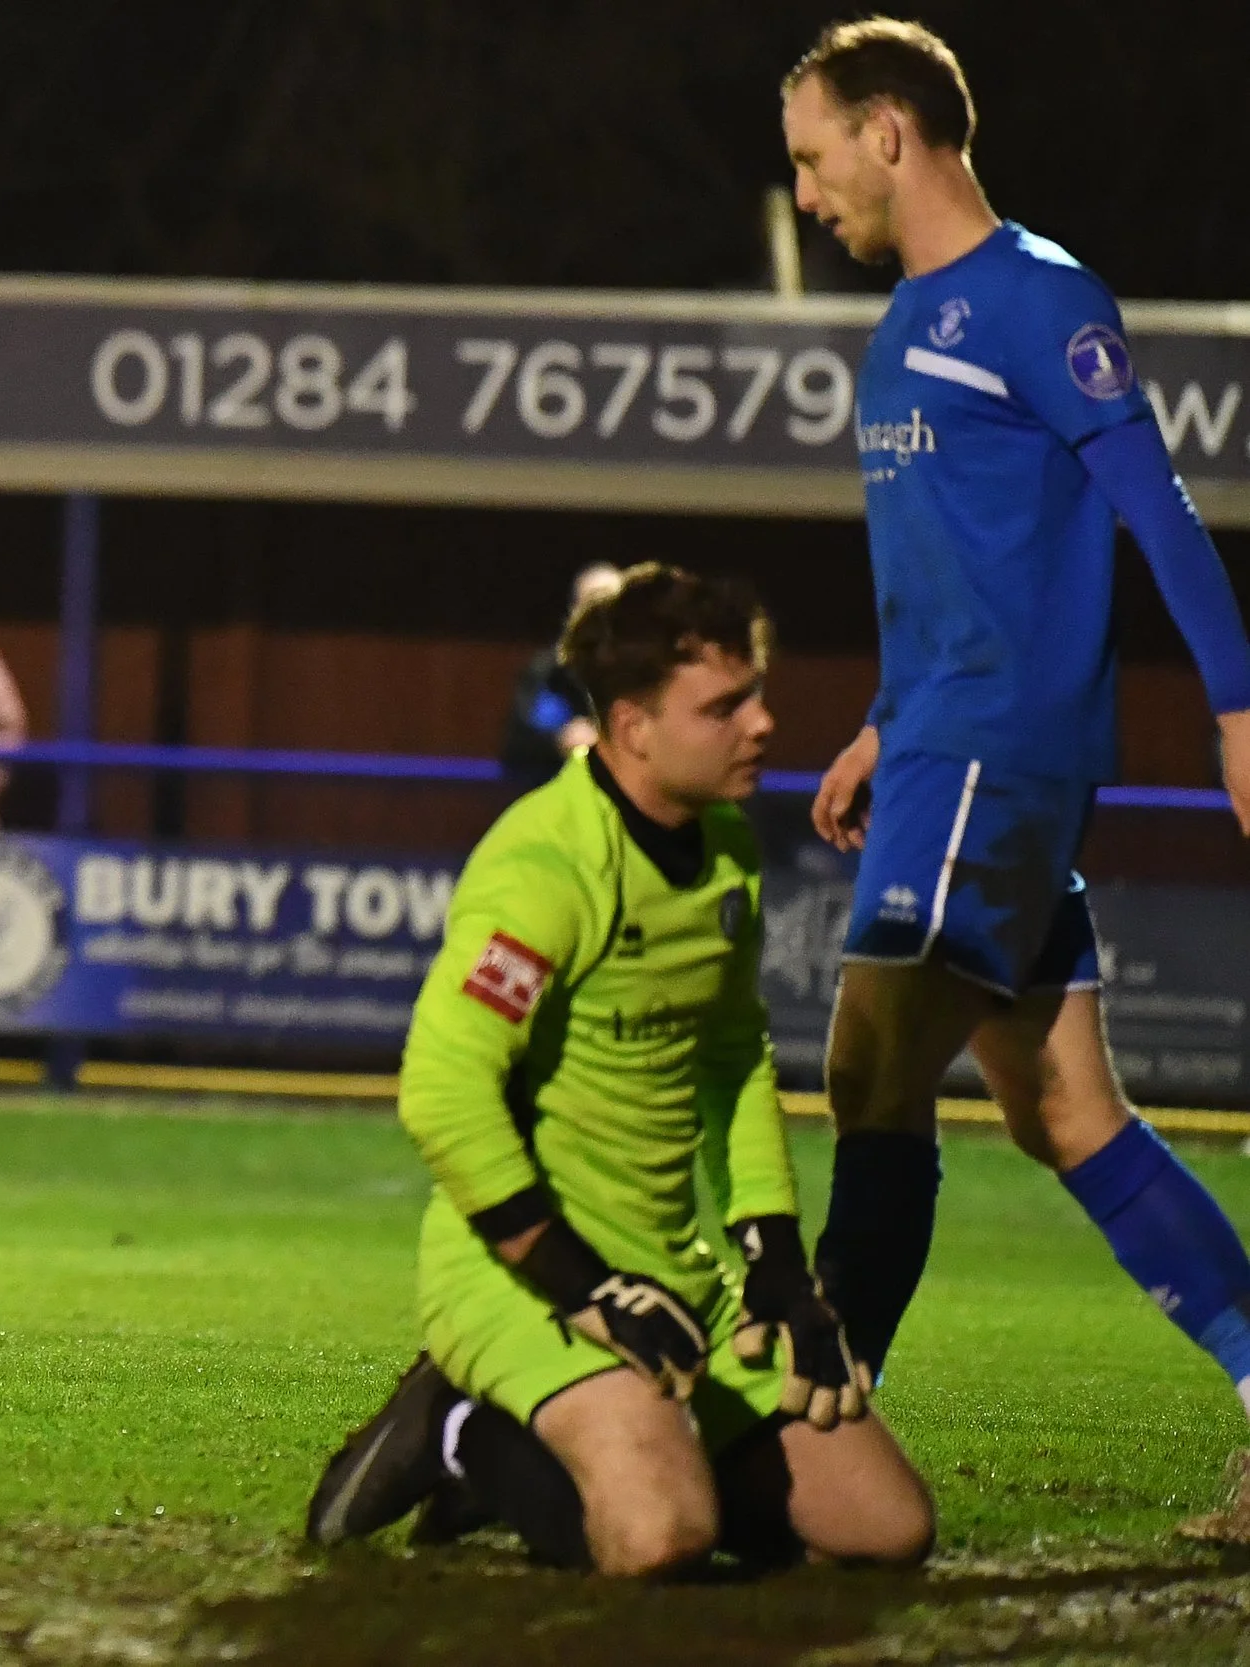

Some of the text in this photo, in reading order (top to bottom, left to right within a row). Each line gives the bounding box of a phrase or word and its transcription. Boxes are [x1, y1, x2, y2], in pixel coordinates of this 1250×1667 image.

[90, 329, 854, 446] 01284 767579
[76, 855, 292, 931] BURY
